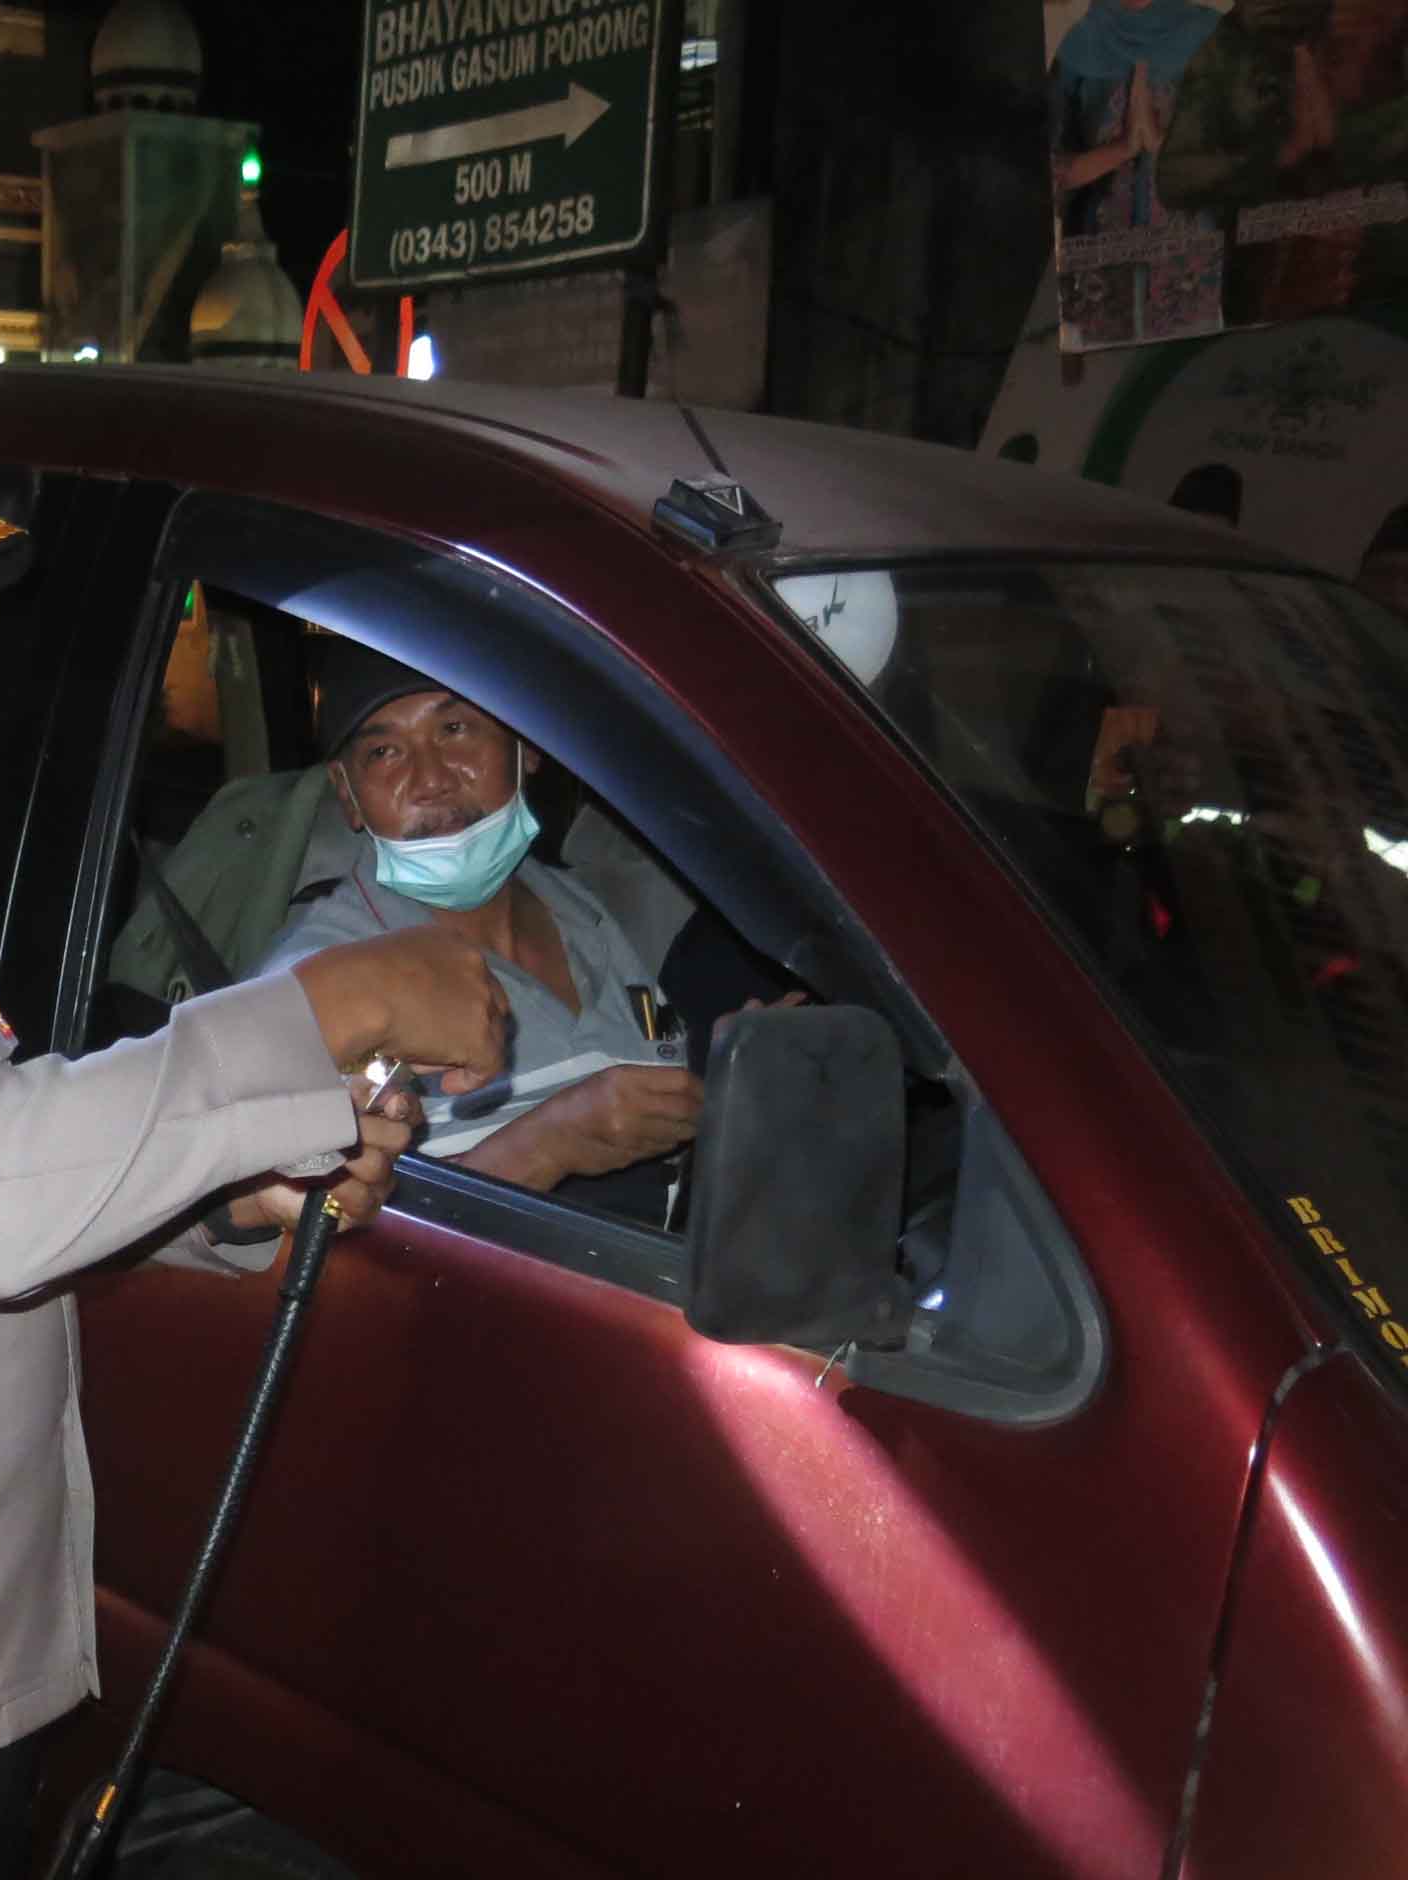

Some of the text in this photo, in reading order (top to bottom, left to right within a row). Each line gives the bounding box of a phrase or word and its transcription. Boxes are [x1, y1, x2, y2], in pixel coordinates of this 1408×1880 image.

[369, 4, 651, 111] PUSDIK GASUM PORONG
[375, 0, 640, 64] BHAYANG
[455, 152, 532, 206] 500 M
[389, 194, 596, 275] (0343) 854258
